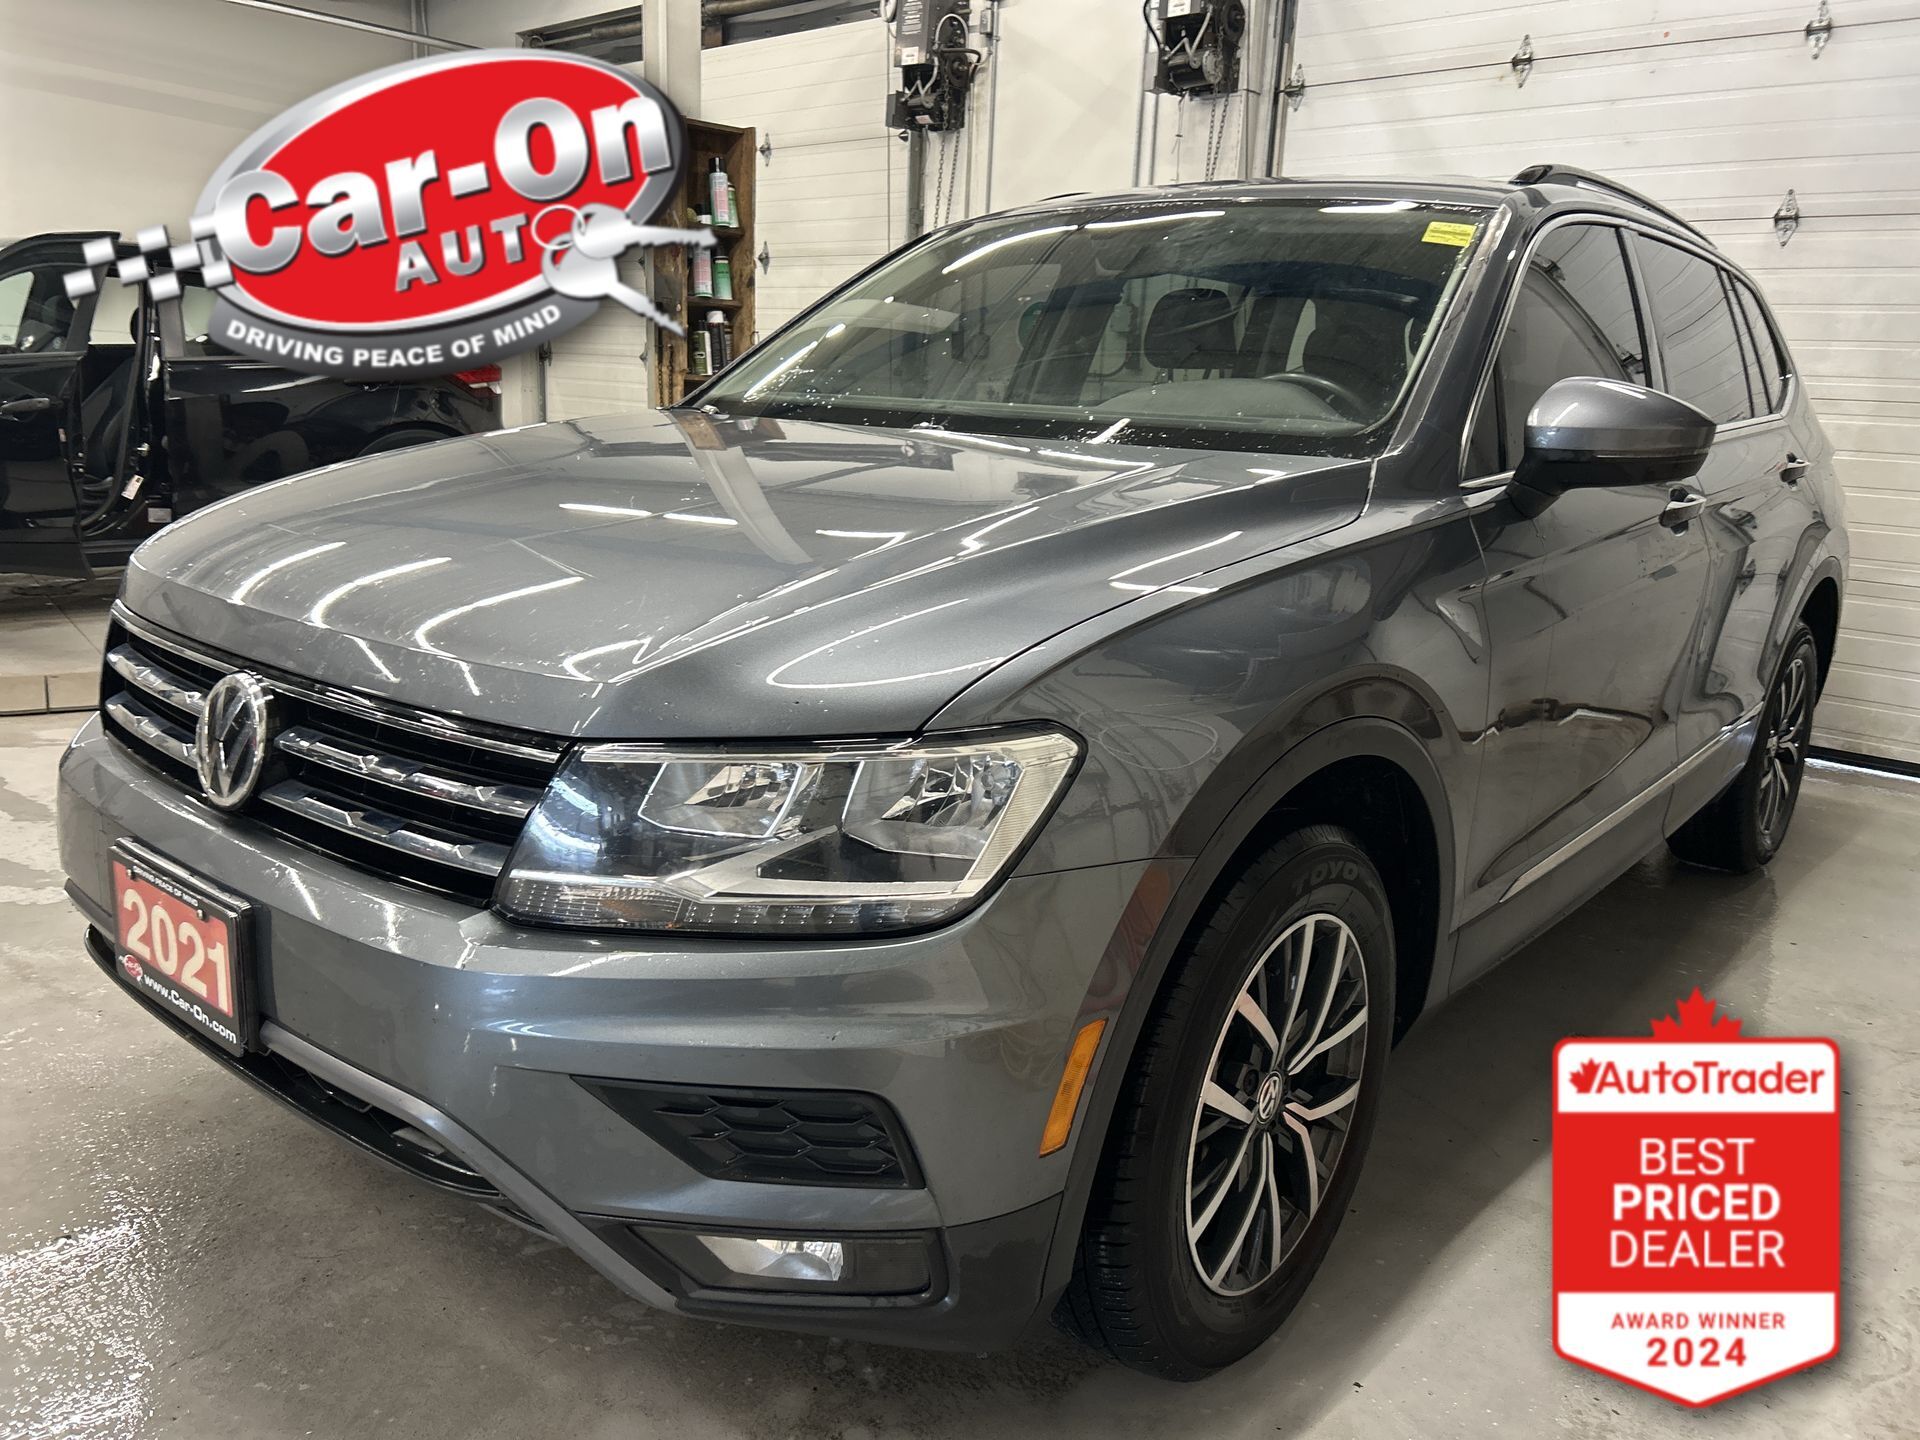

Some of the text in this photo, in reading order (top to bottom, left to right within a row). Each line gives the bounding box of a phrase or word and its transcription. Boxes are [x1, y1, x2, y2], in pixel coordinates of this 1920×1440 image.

[1291, 860, 1359, 897] TOYO
[123, 888, 229, 1014] 2021
[143, 974, 237, 1044] www.Car-On.com
